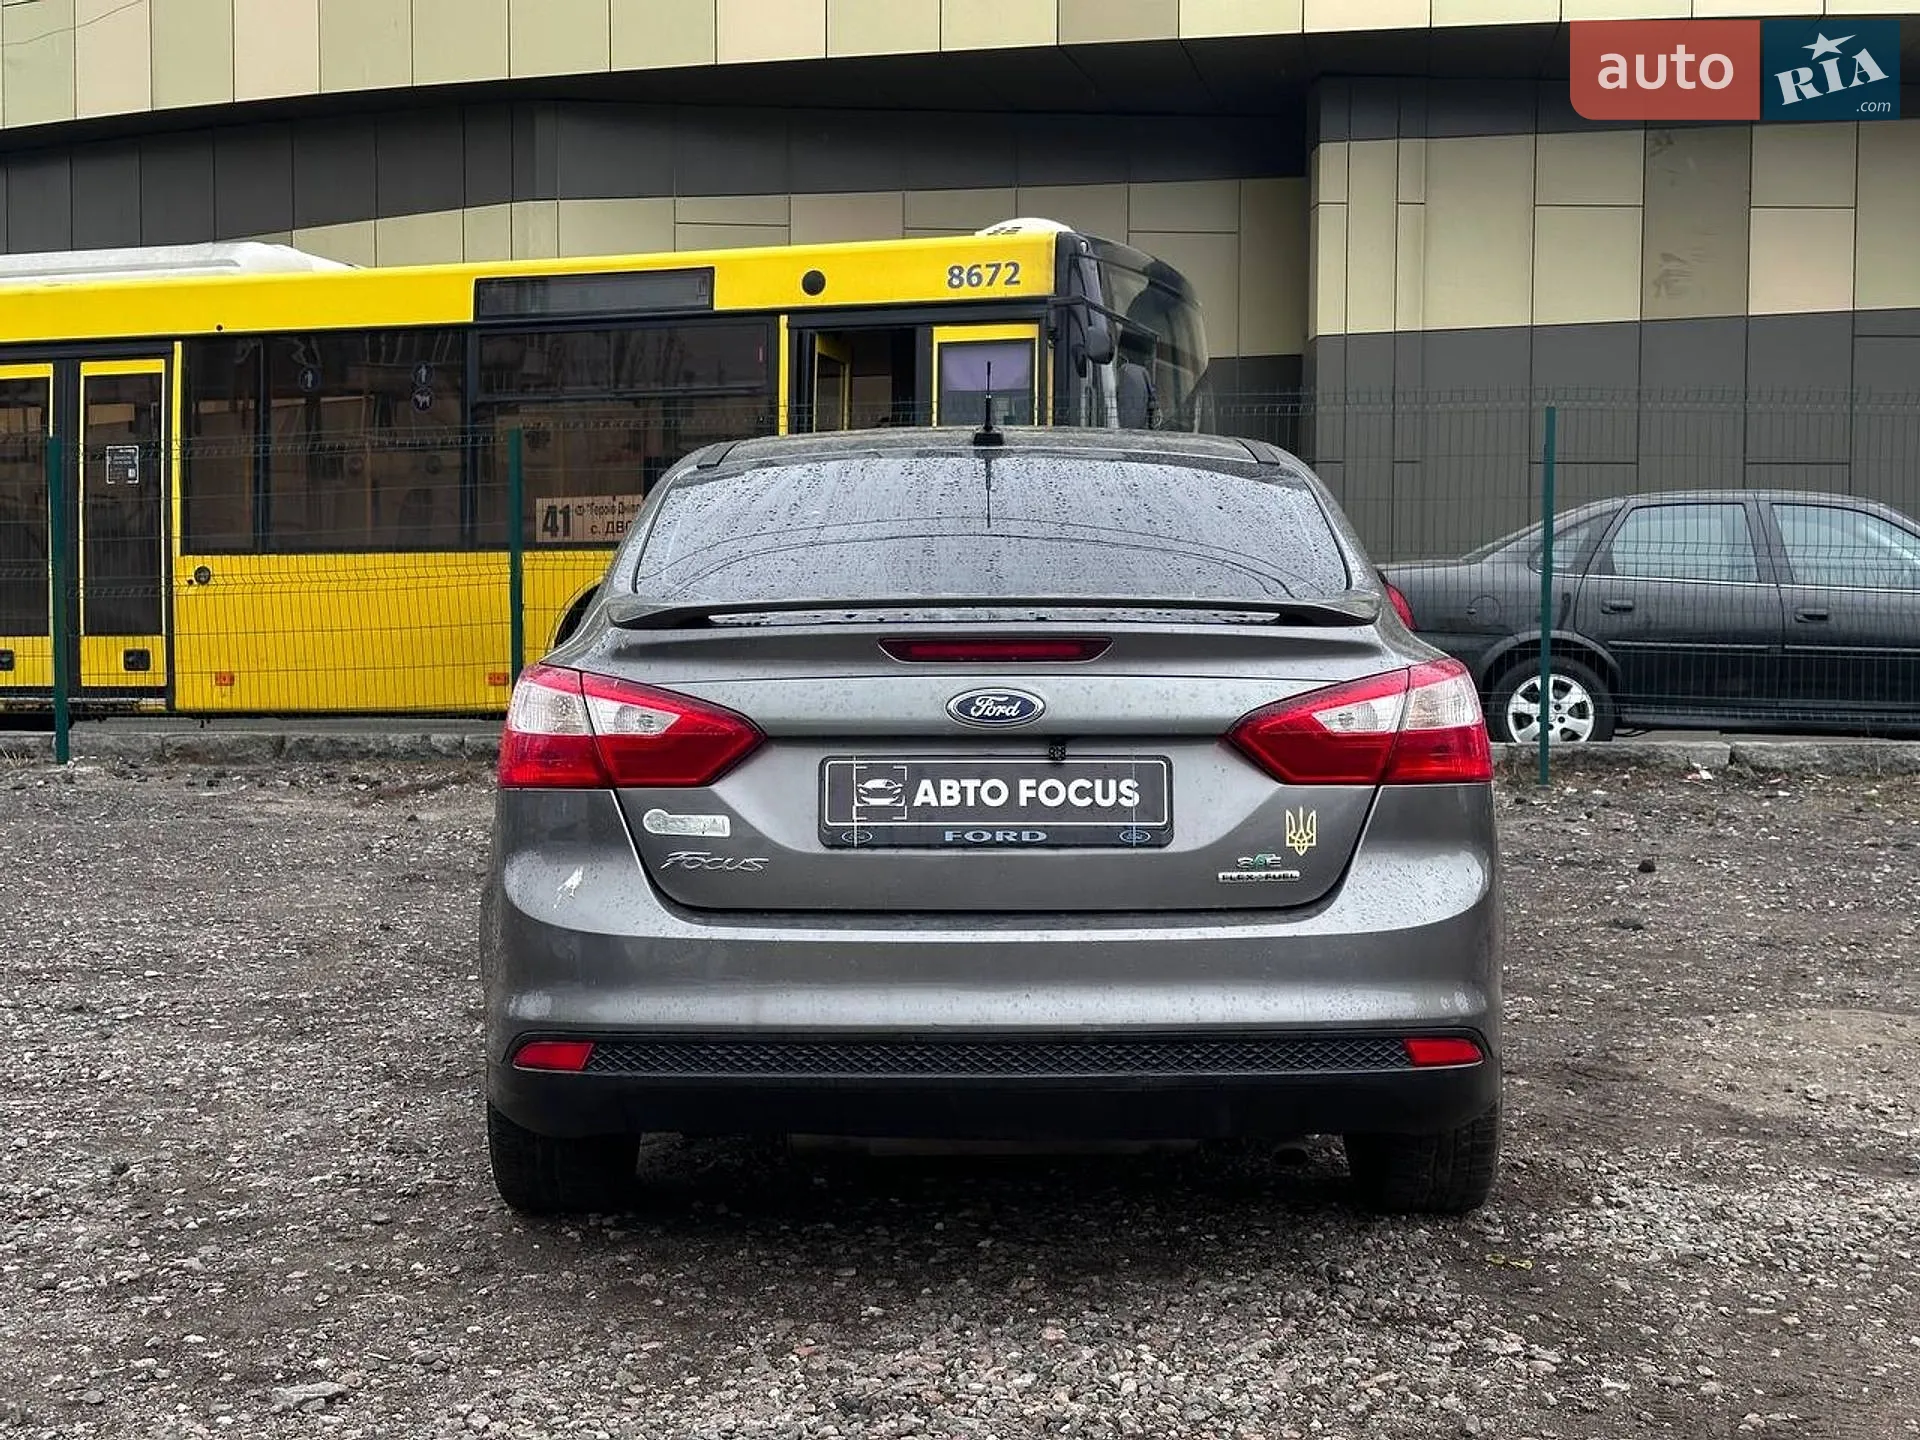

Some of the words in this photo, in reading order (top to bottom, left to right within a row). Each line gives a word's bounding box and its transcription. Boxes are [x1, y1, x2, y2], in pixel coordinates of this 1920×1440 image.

[947, 261, 1021, 289] 8672
[541, 504, 571, 537] 41
[970, 695, 1022, 717] Ford
[1019, 779, 1140, 807] FOCUS
[944, 830, 1047, 842] FORD
